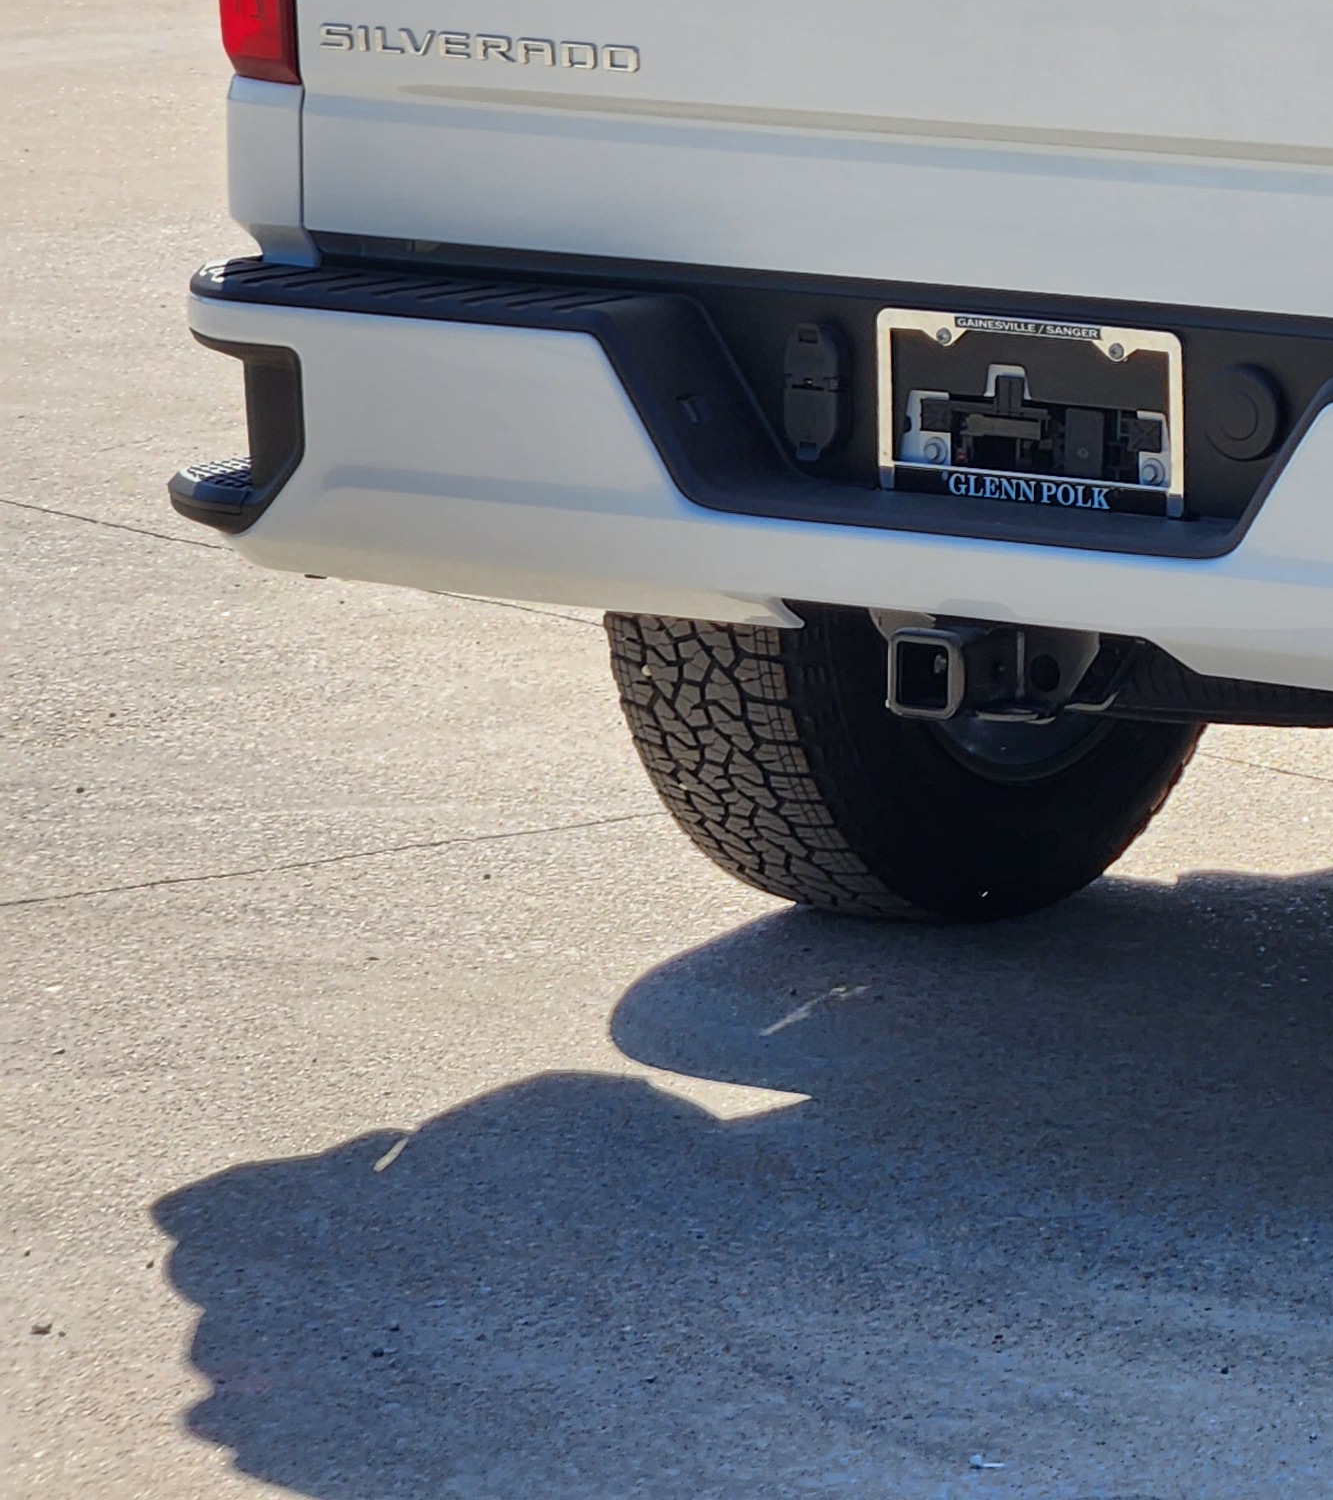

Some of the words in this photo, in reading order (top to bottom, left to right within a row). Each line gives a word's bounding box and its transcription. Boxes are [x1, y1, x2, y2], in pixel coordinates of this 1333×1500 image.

[319, 22, 642, 73] SILVERADO
[956, 317, 1036, 333] GAINESVILLE
[1045, 326, 1099, 339] SANGER
[949, 473, 1037, 502] GLENN
[1039, 481, 1111, 510] POLK
